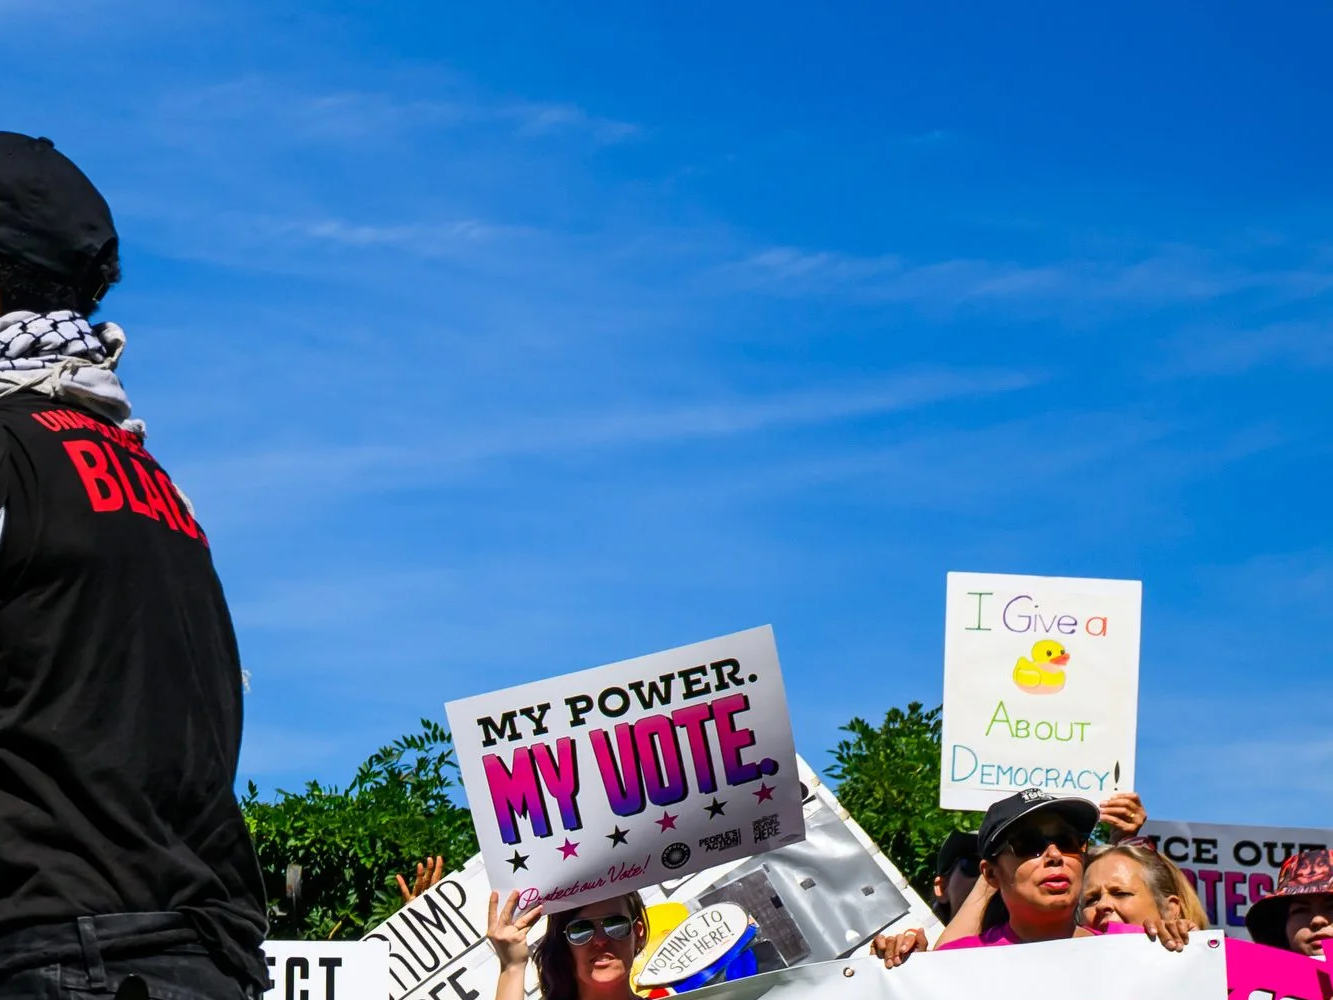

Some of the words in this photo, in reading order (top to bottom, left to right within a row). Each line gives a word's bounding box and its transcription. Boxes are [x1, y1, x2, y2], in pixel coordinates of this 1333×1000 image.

[62, 439, 209, 548] BLAC
[965, 592, 994, 631] I
[1002, 595, 1078, 635] Give
[1085, 616, 1108, 637] a
[477, 703, 551, 747] MY
[565, 658, 757, 727] POWER.
[985, 701, 1091, 742] ABOUT
[482, 736, 583, 844] MY
[589, 693, 779, 816] VOTE.
[699, 829, 737, 847] PEOPLE'S
[705, 838, 738, 852] ACTION
[754, 828, 780, 843] HERE
[518, 886, 583, 911] Protect
[579, 875, 605, 891] our
[608, 855, 651, 881] Vote!
[648, 923, 699, 976] NOTHING
[697, 910, 723, 928] TO
[670, 949, 698, 974] SEE
[693, 921, 735, 955] HERE!
